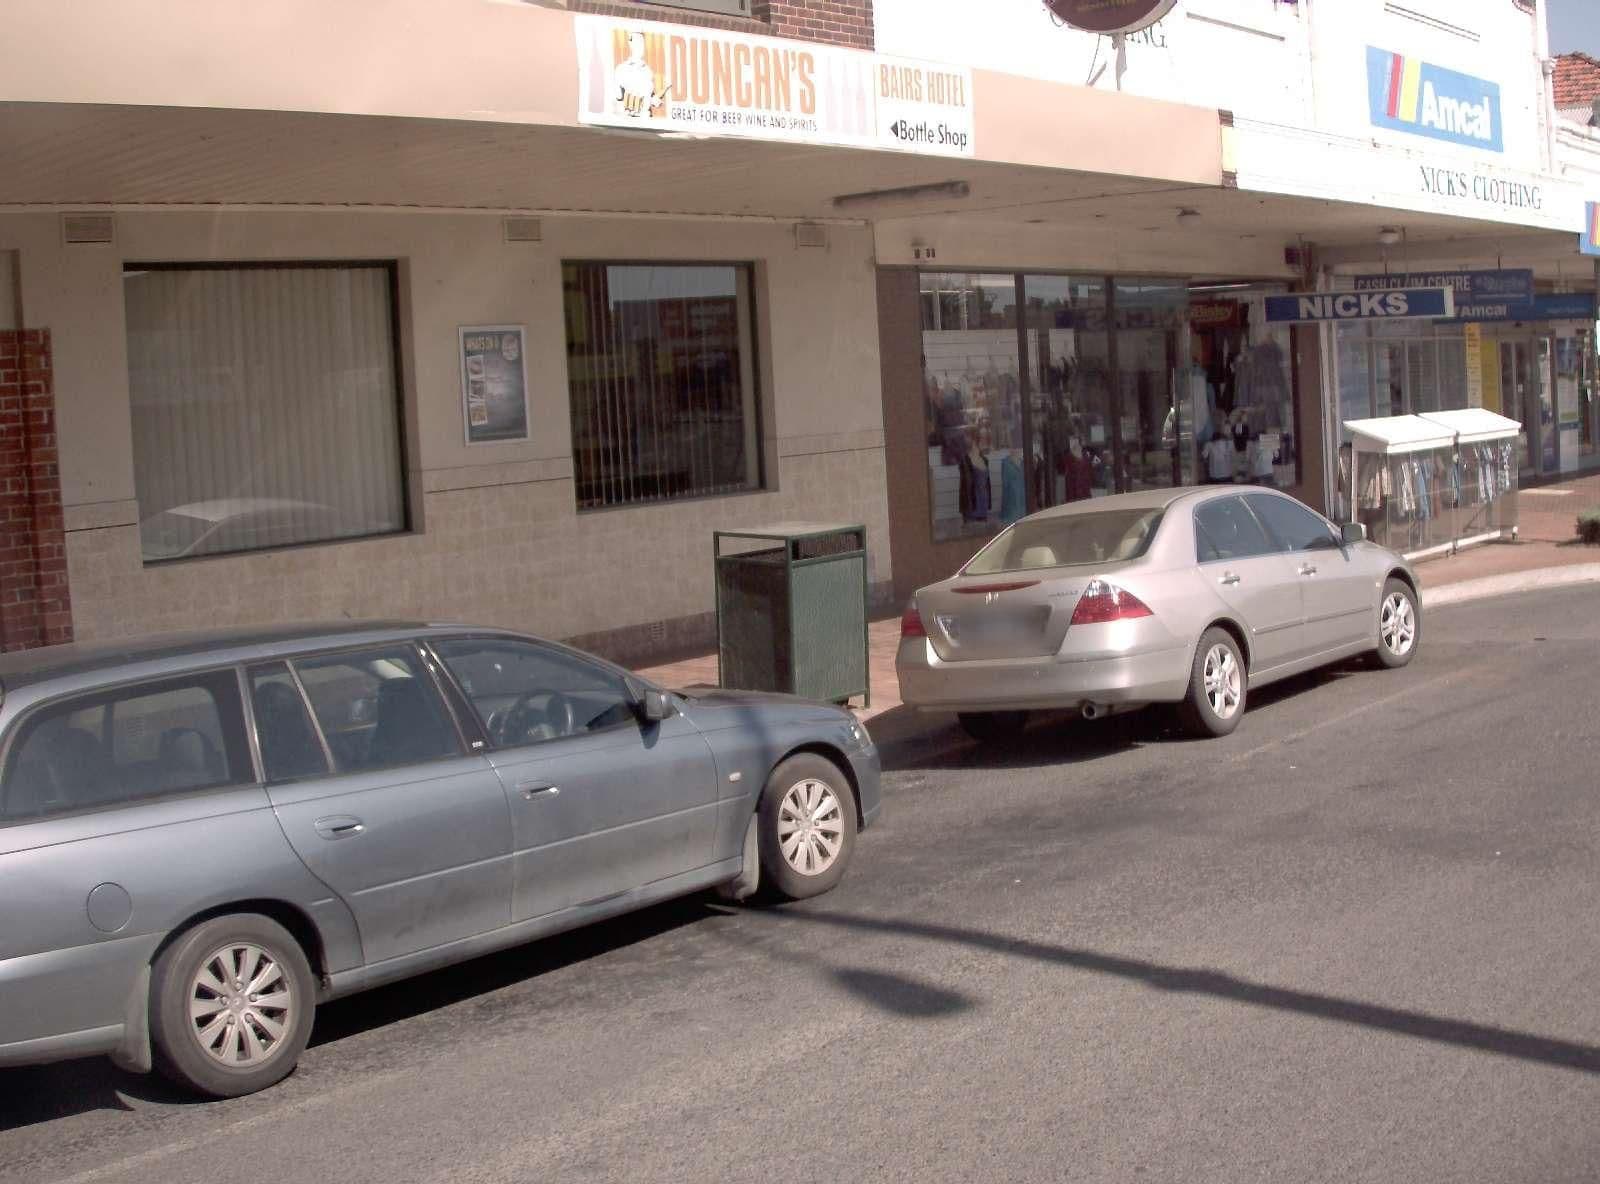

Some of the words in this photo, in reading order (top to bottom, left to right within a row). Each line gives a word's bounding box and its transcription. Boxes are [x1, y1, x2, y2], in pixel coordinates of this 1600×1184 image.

[670, 35, 816, 115] DUNCAN'S
[880, 63, 922, 102] BAIRS
[927, 71, 966, 107] HOTEL
[671, 107, 697, 120] GREAT
[700, 109, 718, 123] FOR
[722, 111, 742, 125] BEER
[745, 115, 767, 127] WINE
[769, 117, 786, 129] AND
[789, 118, 818, 132] SPIRITS
[1421, 80, 1492, 140] Amcal
[900, 119, 935, 143] Bottle
[938, 123, 967, 152] Shop
[1420, 165, 1467, 198] NICK'S
[1473, 175, 1542, 209] CLOTHING
[1299, 291, 1409, 319] NICKS
